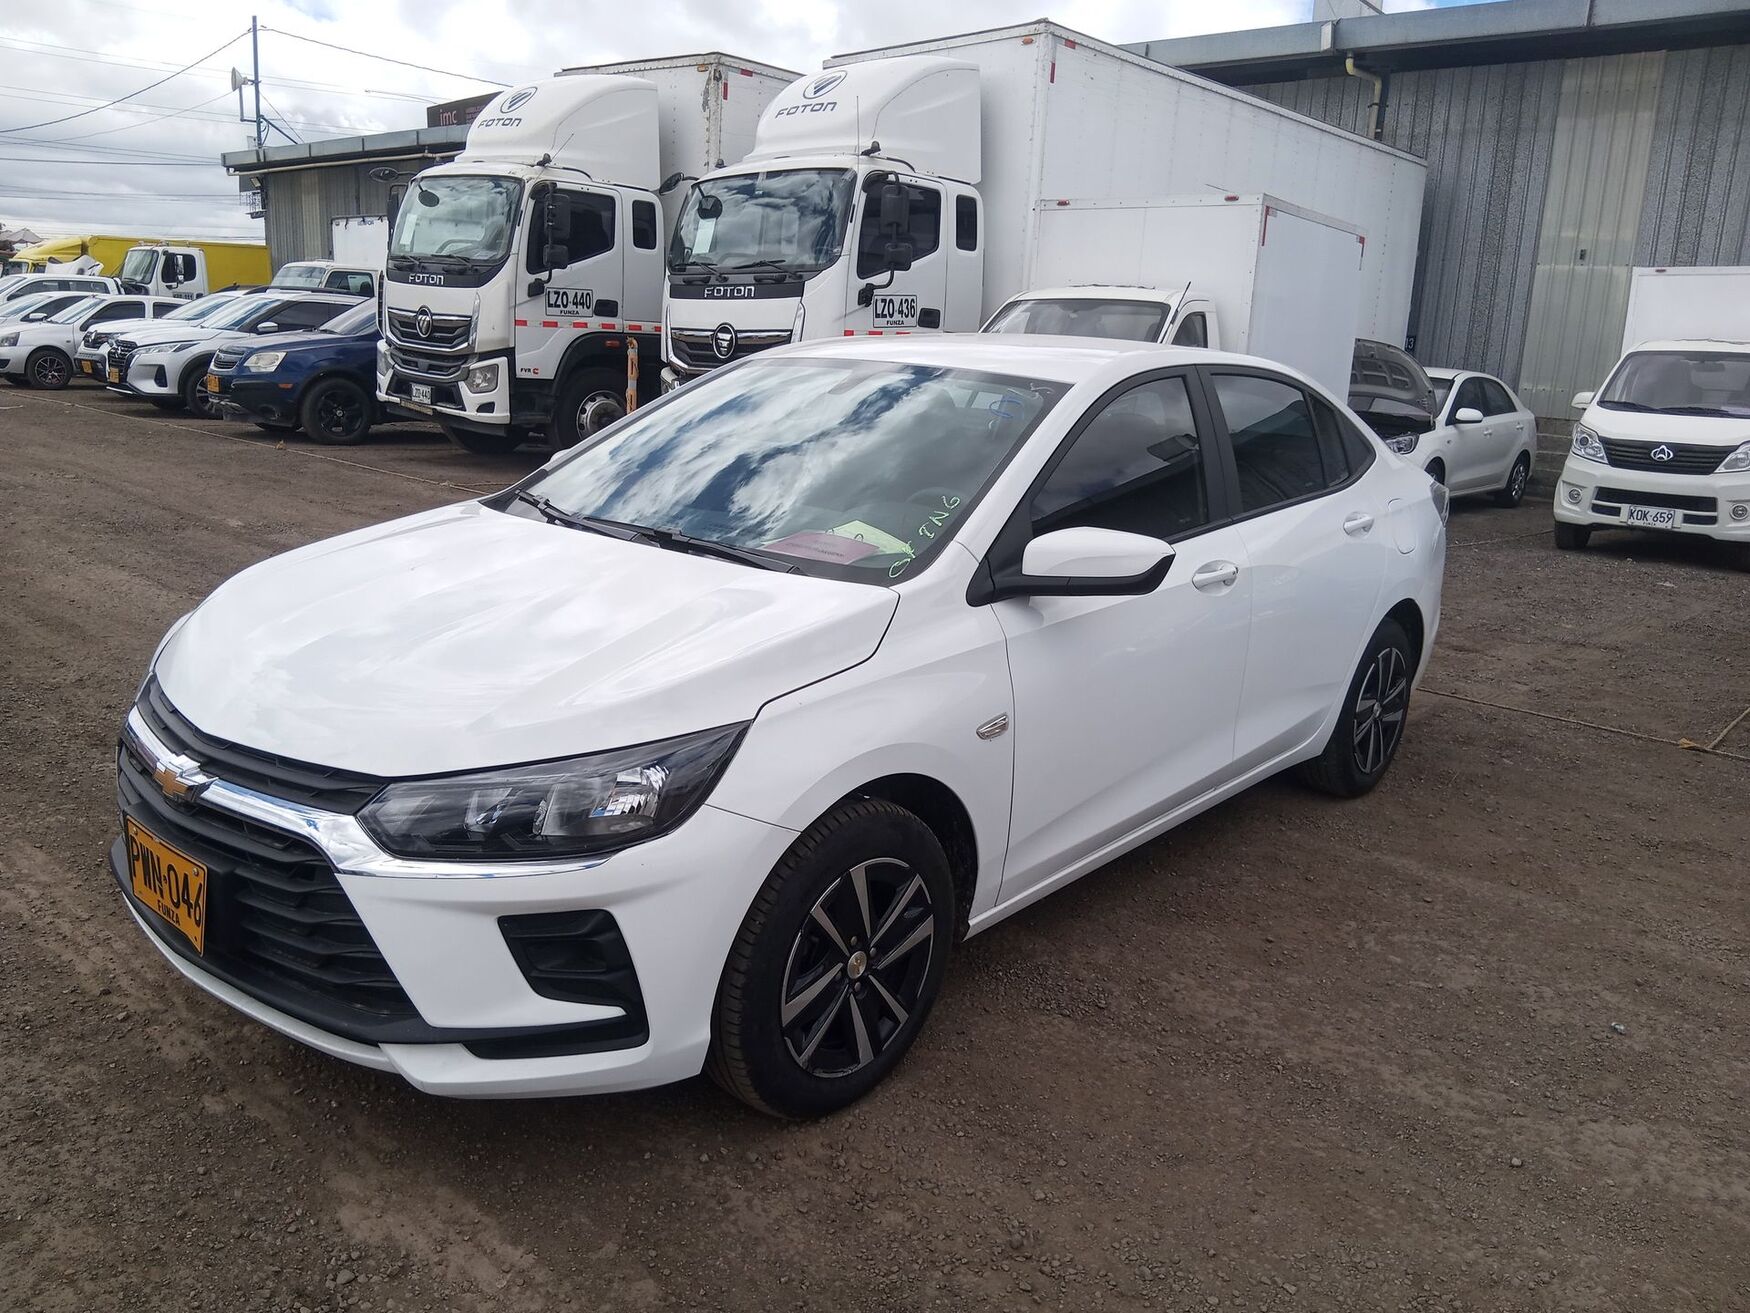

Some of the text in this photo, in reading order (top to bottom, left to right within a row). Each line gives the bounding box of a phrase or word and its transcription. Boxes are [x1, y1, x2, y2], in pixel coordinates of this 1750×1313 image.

[775, 101, 837, 119] FOTON
[478, 118, 522, 129] FOTON
[408, 273, 444, 285] FOTON
[704, 286, 755, 298] FOTON
[157, 899, 181, 927] FUNZA
